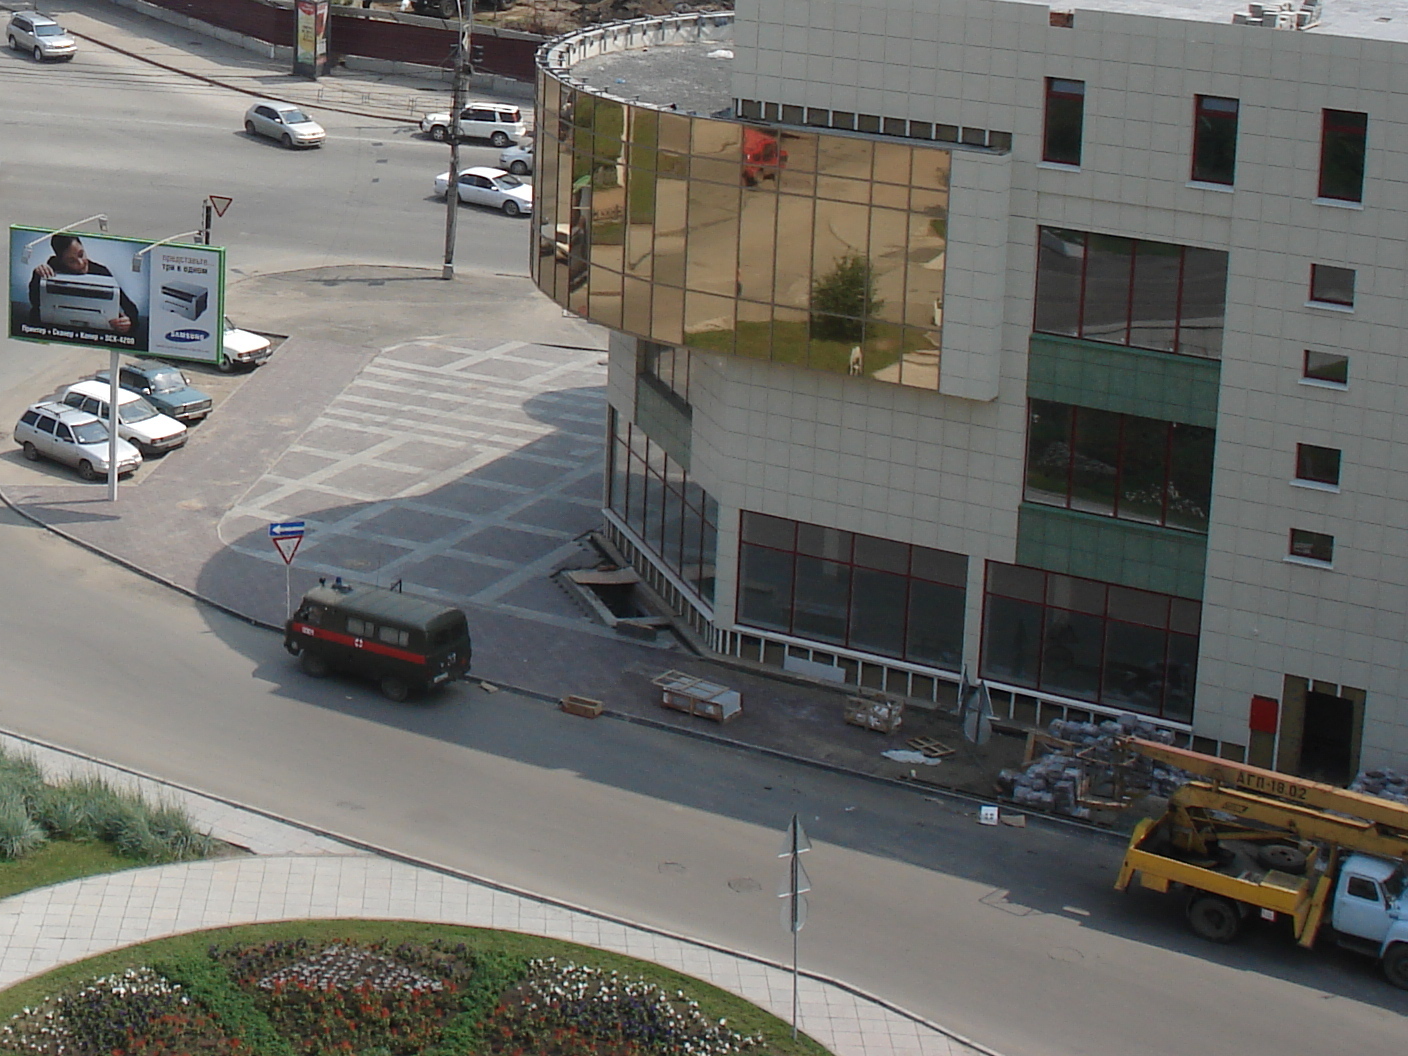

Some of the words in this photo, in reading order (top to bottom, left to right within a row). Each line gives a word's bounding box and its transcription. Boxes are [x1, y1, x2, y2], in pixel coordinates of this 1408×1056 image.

[183, 266, 208, 274] одном
[170, 331, 205, 341] SAMSUNG
[1236, 769, 1307, 800] АГП-18.02
